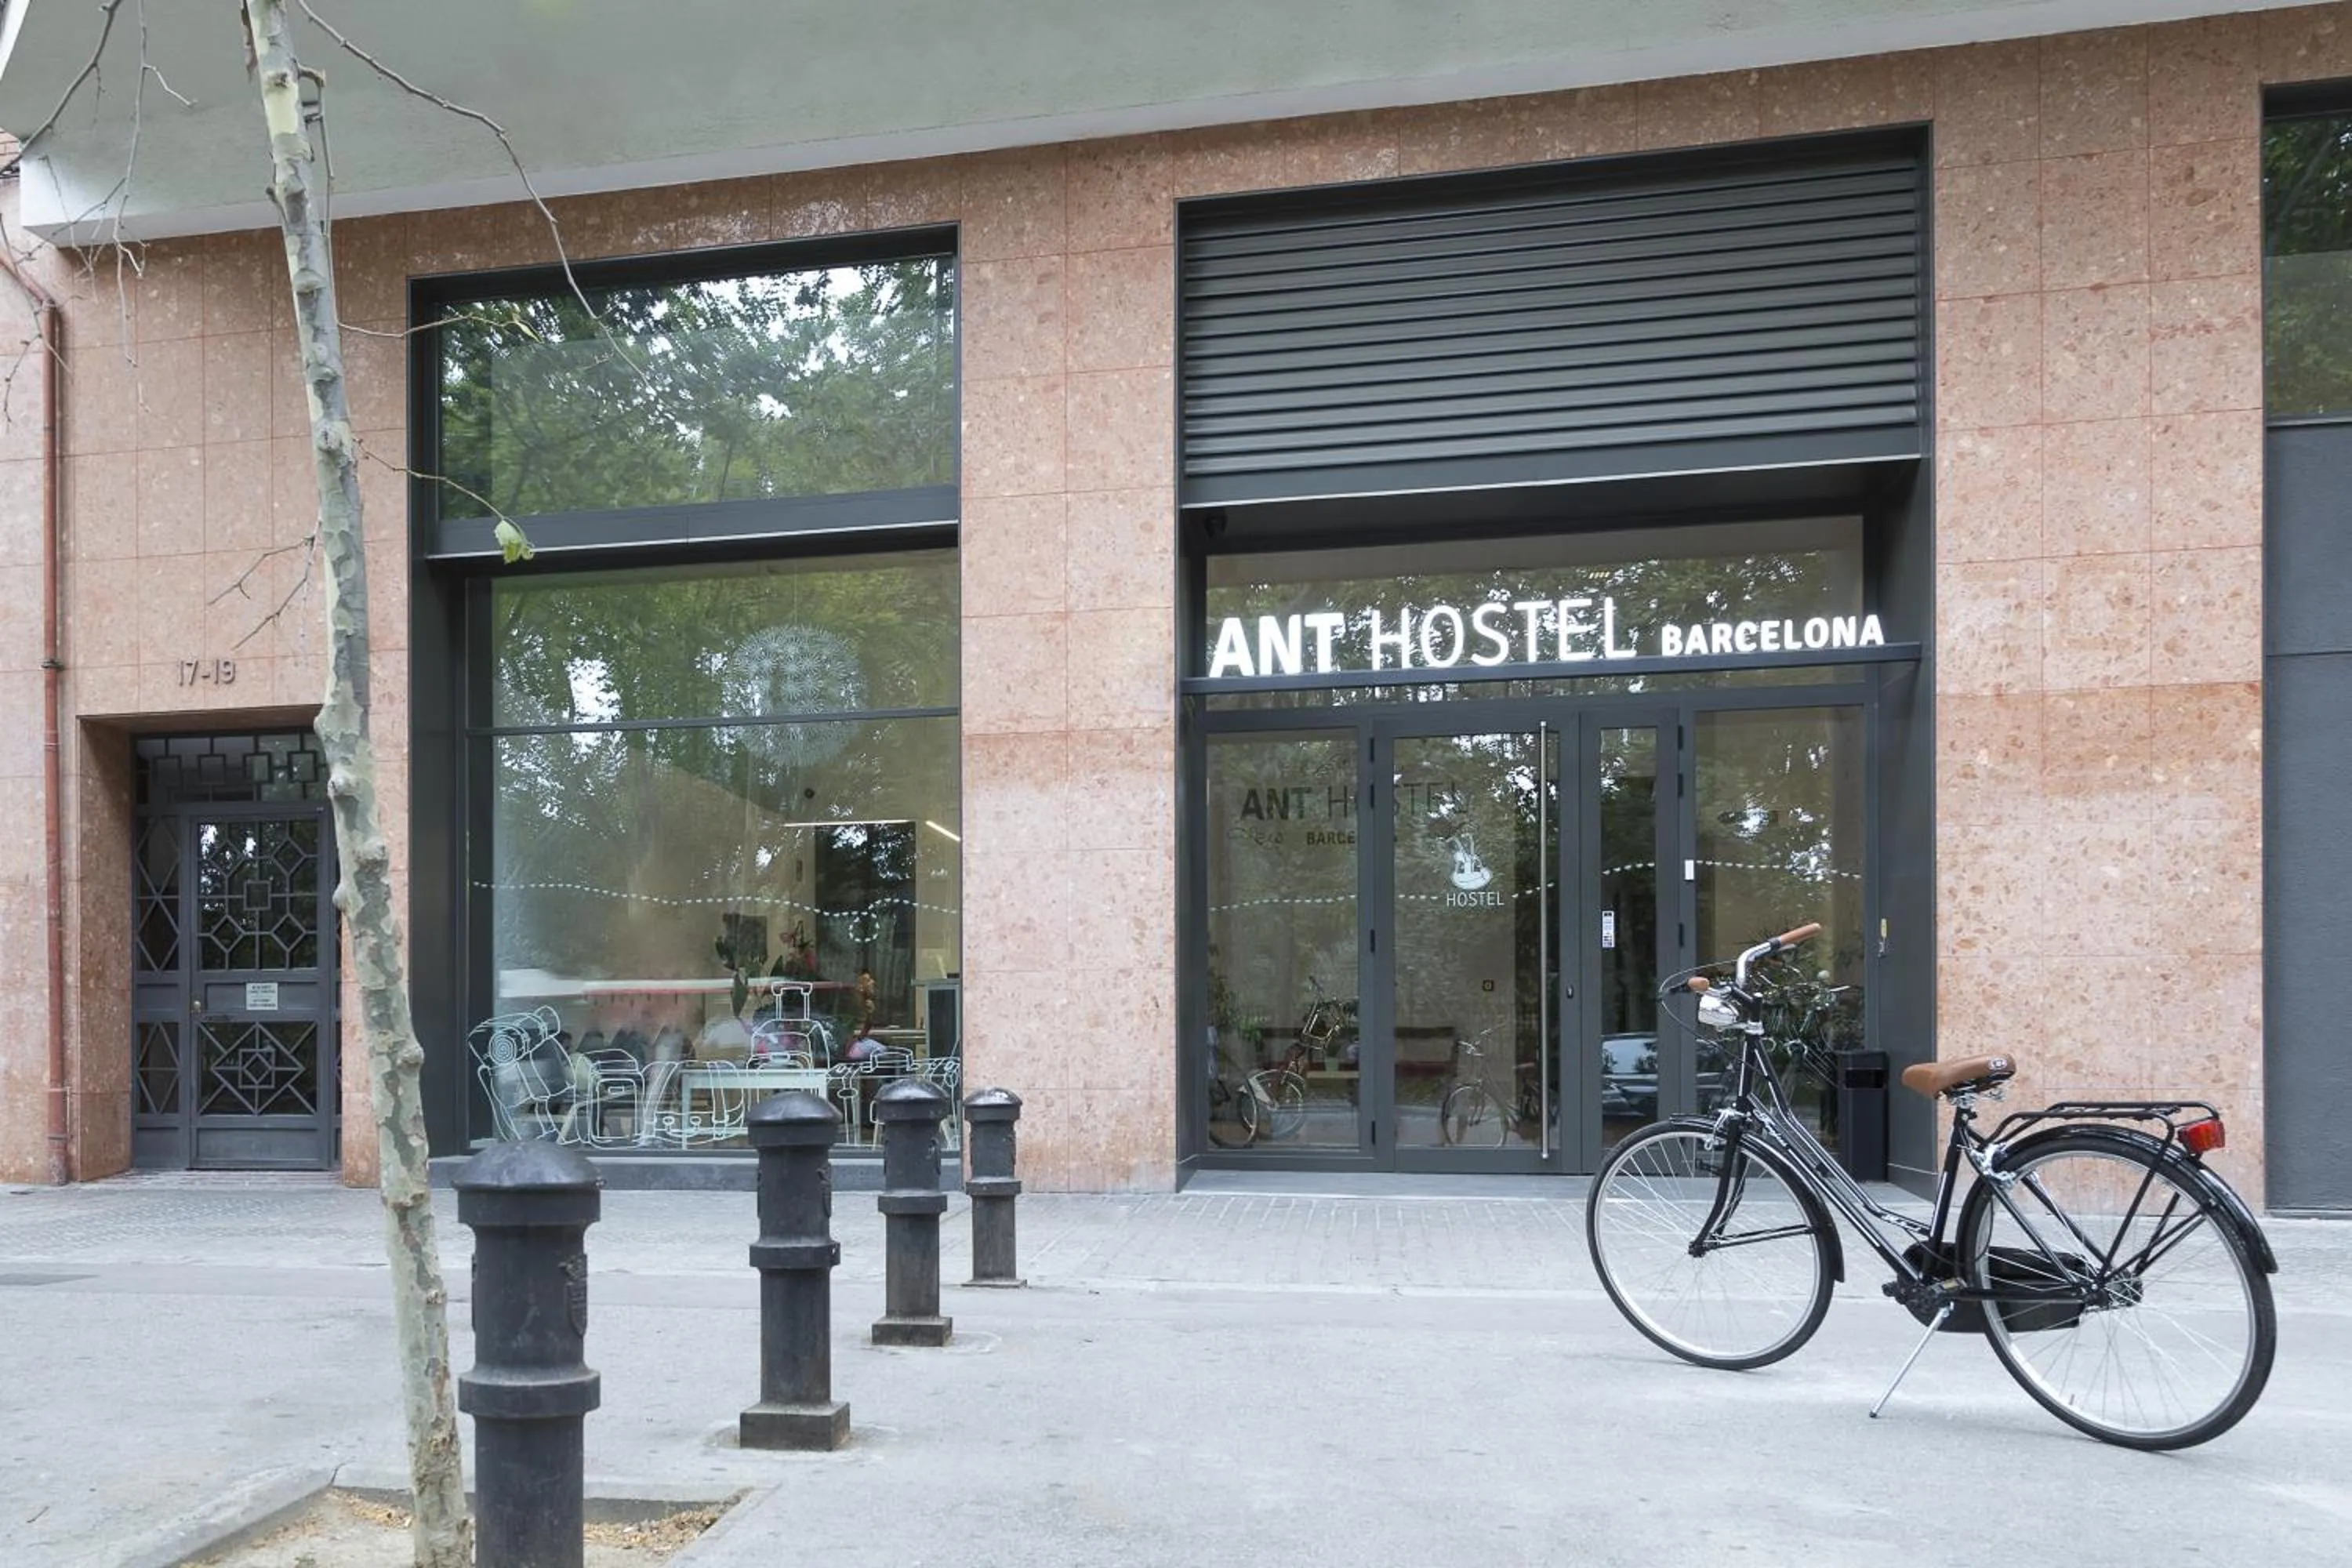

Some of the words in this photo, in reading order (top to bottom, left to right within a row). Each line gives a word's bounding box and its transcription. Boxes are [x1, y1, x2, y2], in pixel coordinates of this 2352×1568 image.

[1209, 612, 1345, 677] ANT
[1371, 597, 1637, 671] HOSTEL
[1661, 614, 1885, 656] BARCELONA
[178, 659, 236, 687] 17-19
[1240, 786, 1312, 820] ANT
[1327, 782, 1468, 818] HTEL
[1446, 891, 1505, 908] HOSTEL
